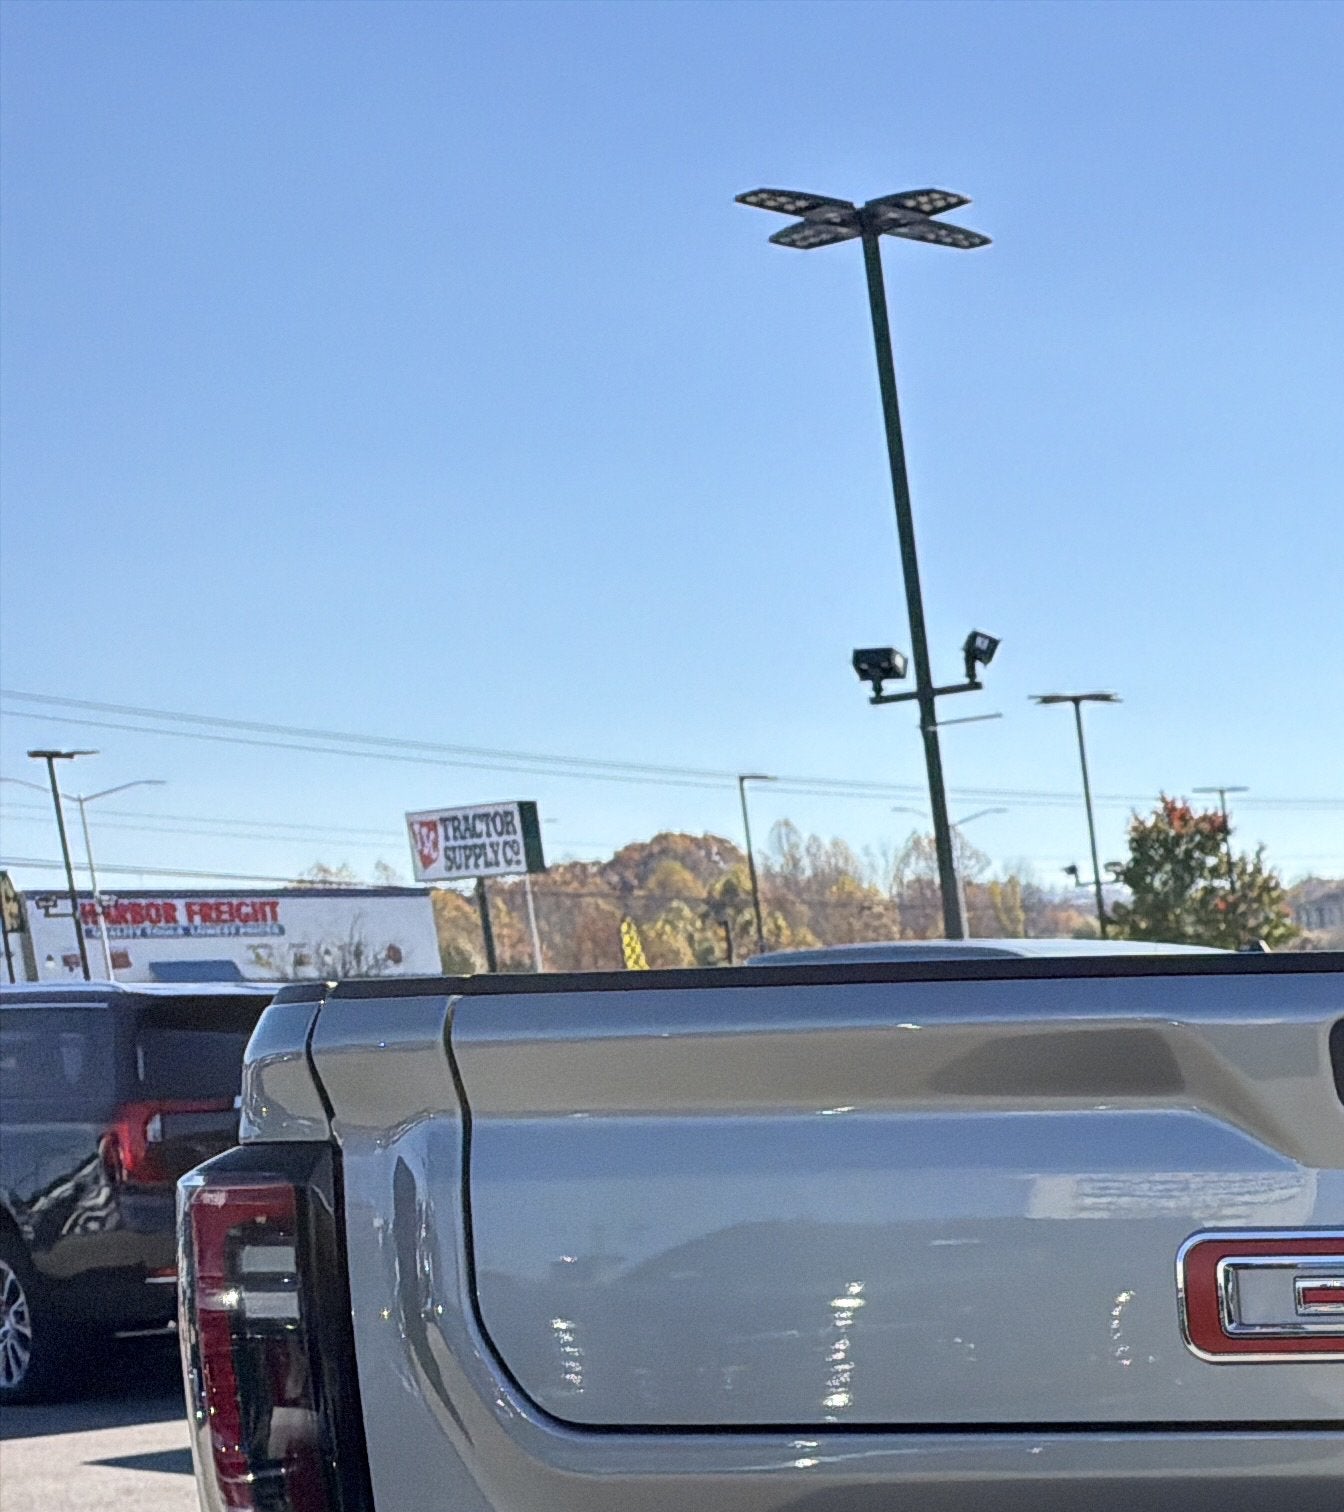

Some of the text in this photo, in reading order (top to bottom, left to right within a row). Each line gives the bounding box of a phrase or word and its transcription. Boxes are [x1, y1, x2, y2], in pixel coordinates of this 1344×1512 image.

[439, 811, 518, 842] TRACTOR
[444, 841, 501, 871] SUPPLY
[185, 900, 280, 923] FREIGHT
